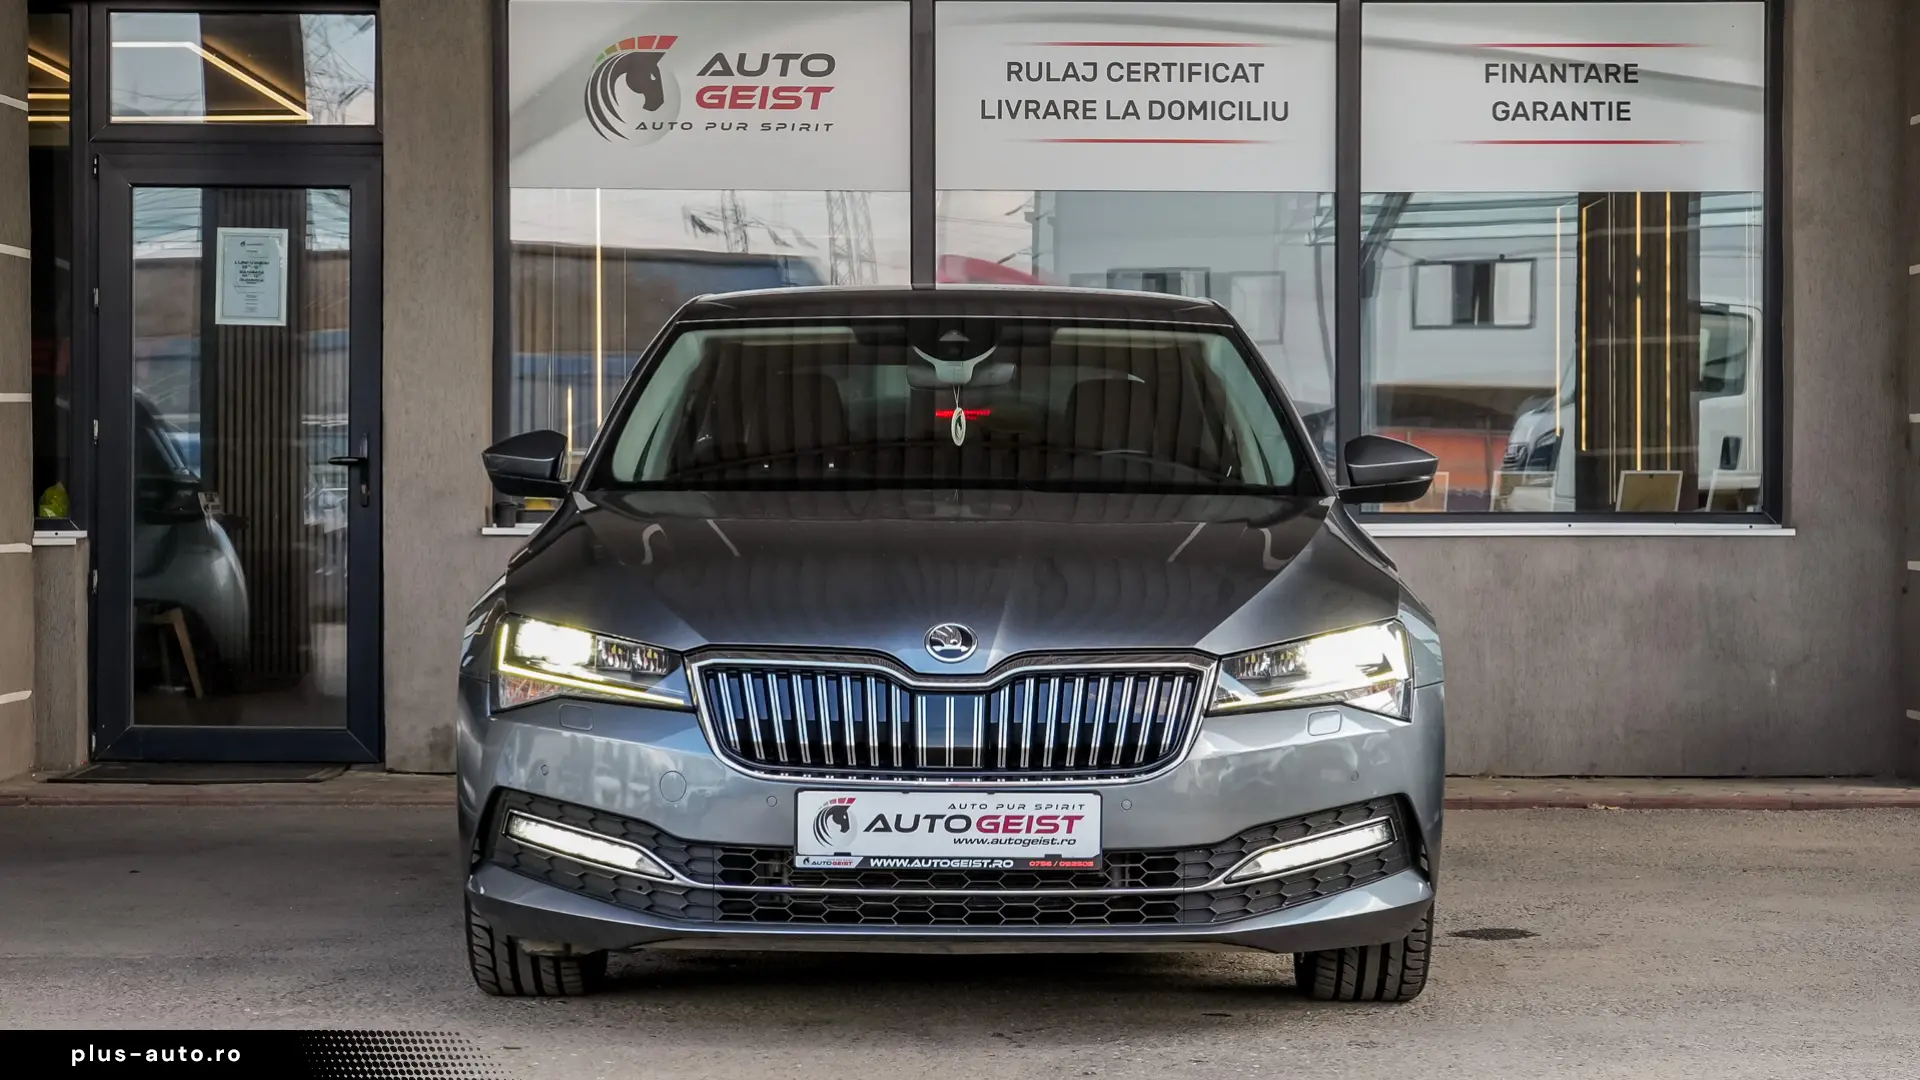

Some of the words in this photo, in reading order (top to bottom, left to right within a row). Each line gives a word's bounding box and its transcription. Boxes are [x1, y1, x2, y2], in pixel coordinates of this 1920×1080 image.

[697, 53, 835, 78] AUTO
[1006, 61, 1098, 83] RULAJ
[1106, 61, 1265, 84] CERTIFICAT
[1485, 62, 1639, 84] FINANTARE
[695, 85, 835, 111] GEIST
[980, 99, 1097, 120] LIVRARE
[1105, 99, 1141, 121] LA
[1148, 99, 1290, 122] DOMICILIU
[1492, 100, 1632, 122] GARANTIE
[635, 121, 693, 131] AUTO
[704, 122, 749, 132] PUR
[760, 122, 835, 132] SPIRIT
[995, 803, 1026, 811] PUR
[1034, 803, 1085, 811] SPIRIT
[863, 814, 1085, 835] AUTOGEIST
[953, 836, 1077, 848] www.autogeist.ro
[869, 856, 1015, 869] WWW.AUTOGEIST.RO
